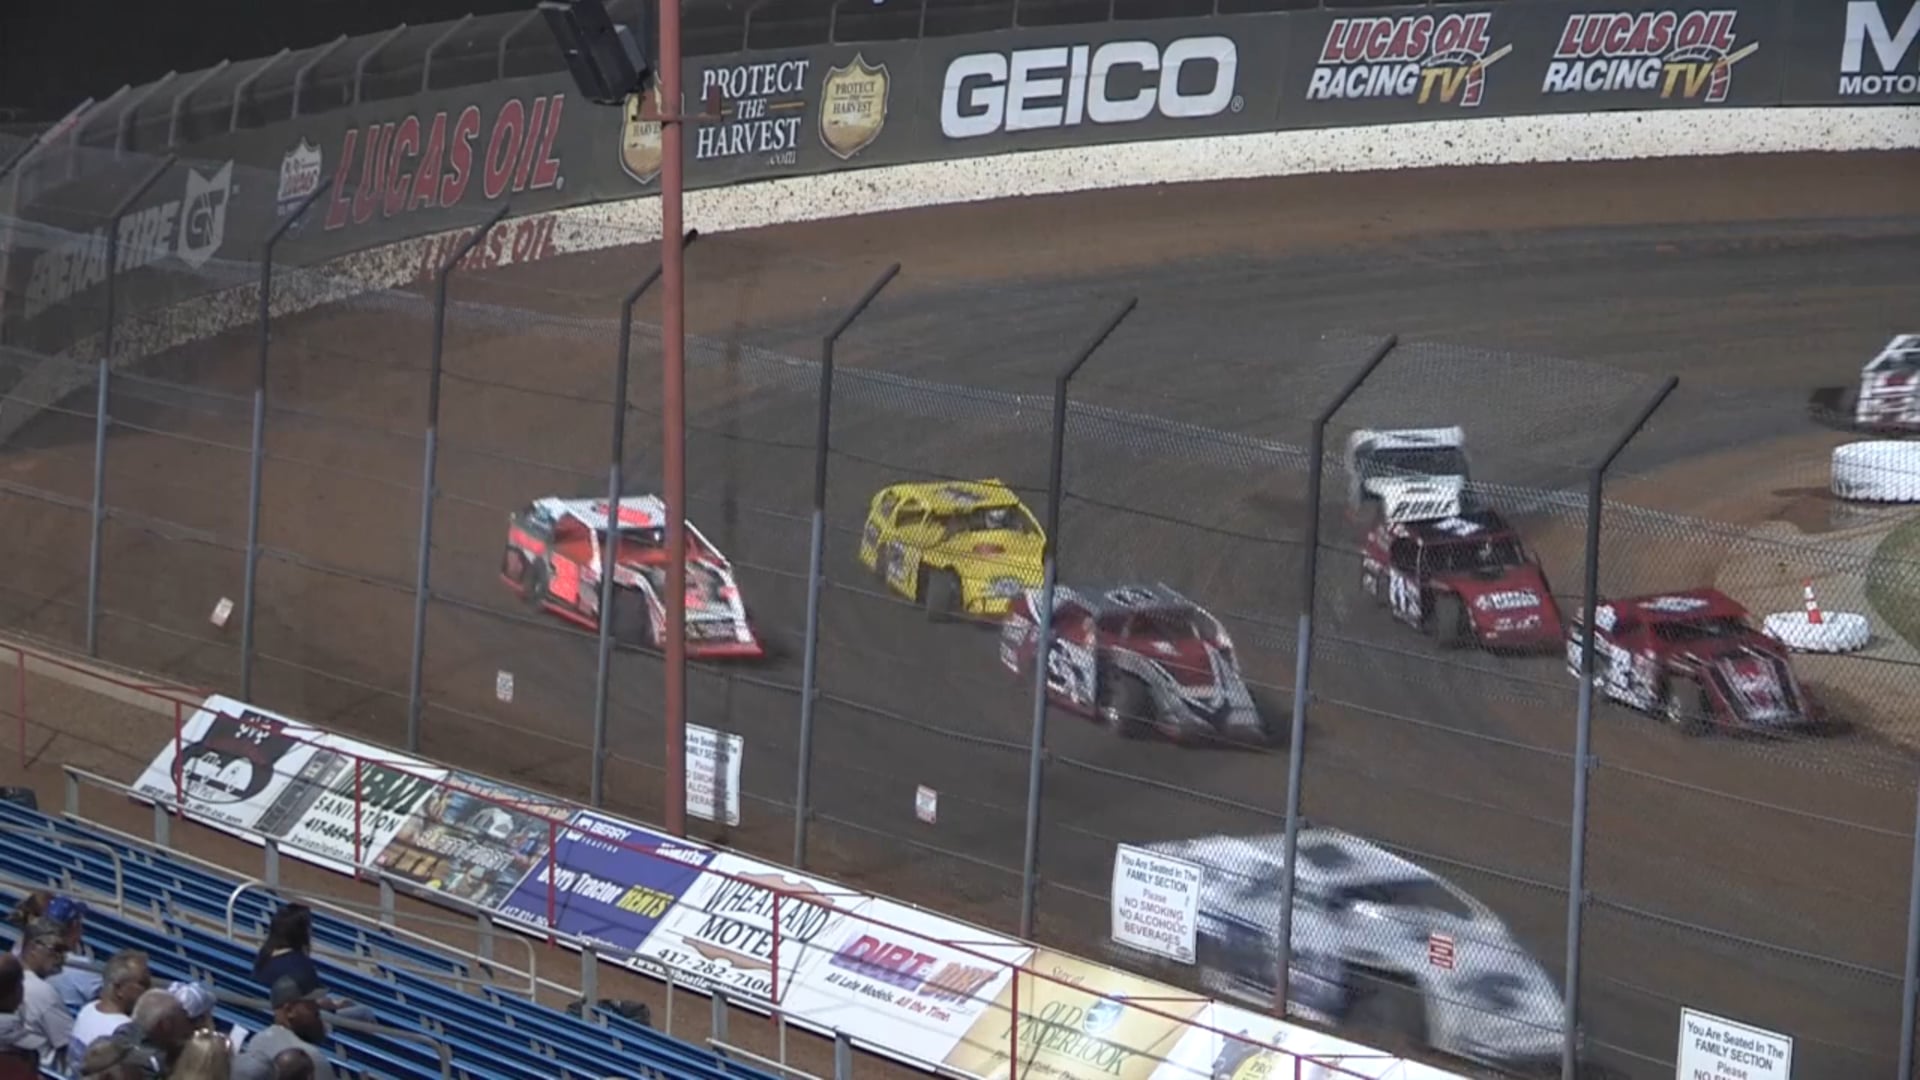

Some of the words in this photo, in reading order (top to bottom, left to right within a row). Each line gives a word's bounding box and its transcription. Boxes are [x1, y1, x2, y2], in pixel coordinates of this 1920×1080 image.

[1318, 15, 1434, 64] LUCAS
[1433, 13, 1491, 56] OIL
[1553, 11, 1676, 58] LUCAS
[1675, 10, 1737, 52] OIL
[701, 60, 809, 100] PROTECT
[835, 81, 875, 95] PROTECT
[940, 36, 1238, 138] GEICO
[1306, 63, 1420, 100] RACING
[1542, 58, 1661, 93] RACING
[1839, 75, 1920, 95] MOTO
[736, 98, 766, 120] THE
[833, 101, 872, 114] HARVEST
[696, 117, 800, 159] HARVEST
[324, 105, 480, 230] LUCAS
[483, 94, 564, 199] OIL
[113, 200, 181, 274] TIRE
[419, 222, 507, 282] LUCAS
[511, 213, 557, 264] OIL
[313, 796, 401, 834] SANITATION
[590, 820, 632, 841] BERRY
[1121, 854, 1134, 867] You
[1135, 858, 1148, 870] Are
[1149, 861, 1174, 877] Seated
[1175, 868, 1183, 878] In
[1184, 869, 1198, 882] The
[1126, 867, 1154, 884] FAMILY
[1154, 875, 1189, 894] SECTION
[572, 872, 625, 905] Tractor
[615, 885, 675, 919] RENTS
[1124, 896, 1138, 908] NO
[1139, 900, 1184, 921] SMOKING
[1142, 888, 1168, 904] Please
[1119, 907, 1133, 920] NO
[1133, 911, 1188, 935] ALCOHOLIC
[1123, 921, 1181, 946] BEVERAGES
[831, 935, 938, 991] DIRT
[1040, 1000, 1083, 1028] OLD
[1687, 1021, 1705, 1037] You
[1705, 1027, 1722, 1040] Are
[1722, 1031, 1754, 1051] Seated
[1755, 1044, 1765, 1053] In
[1767, 1043, 1784, 1060] The
[1695, 1039, 1729, 1058] FAMILY
[1730, 1049, 1773, 1071] SECTION
[1716, 1061, 1748, 1079] Please
